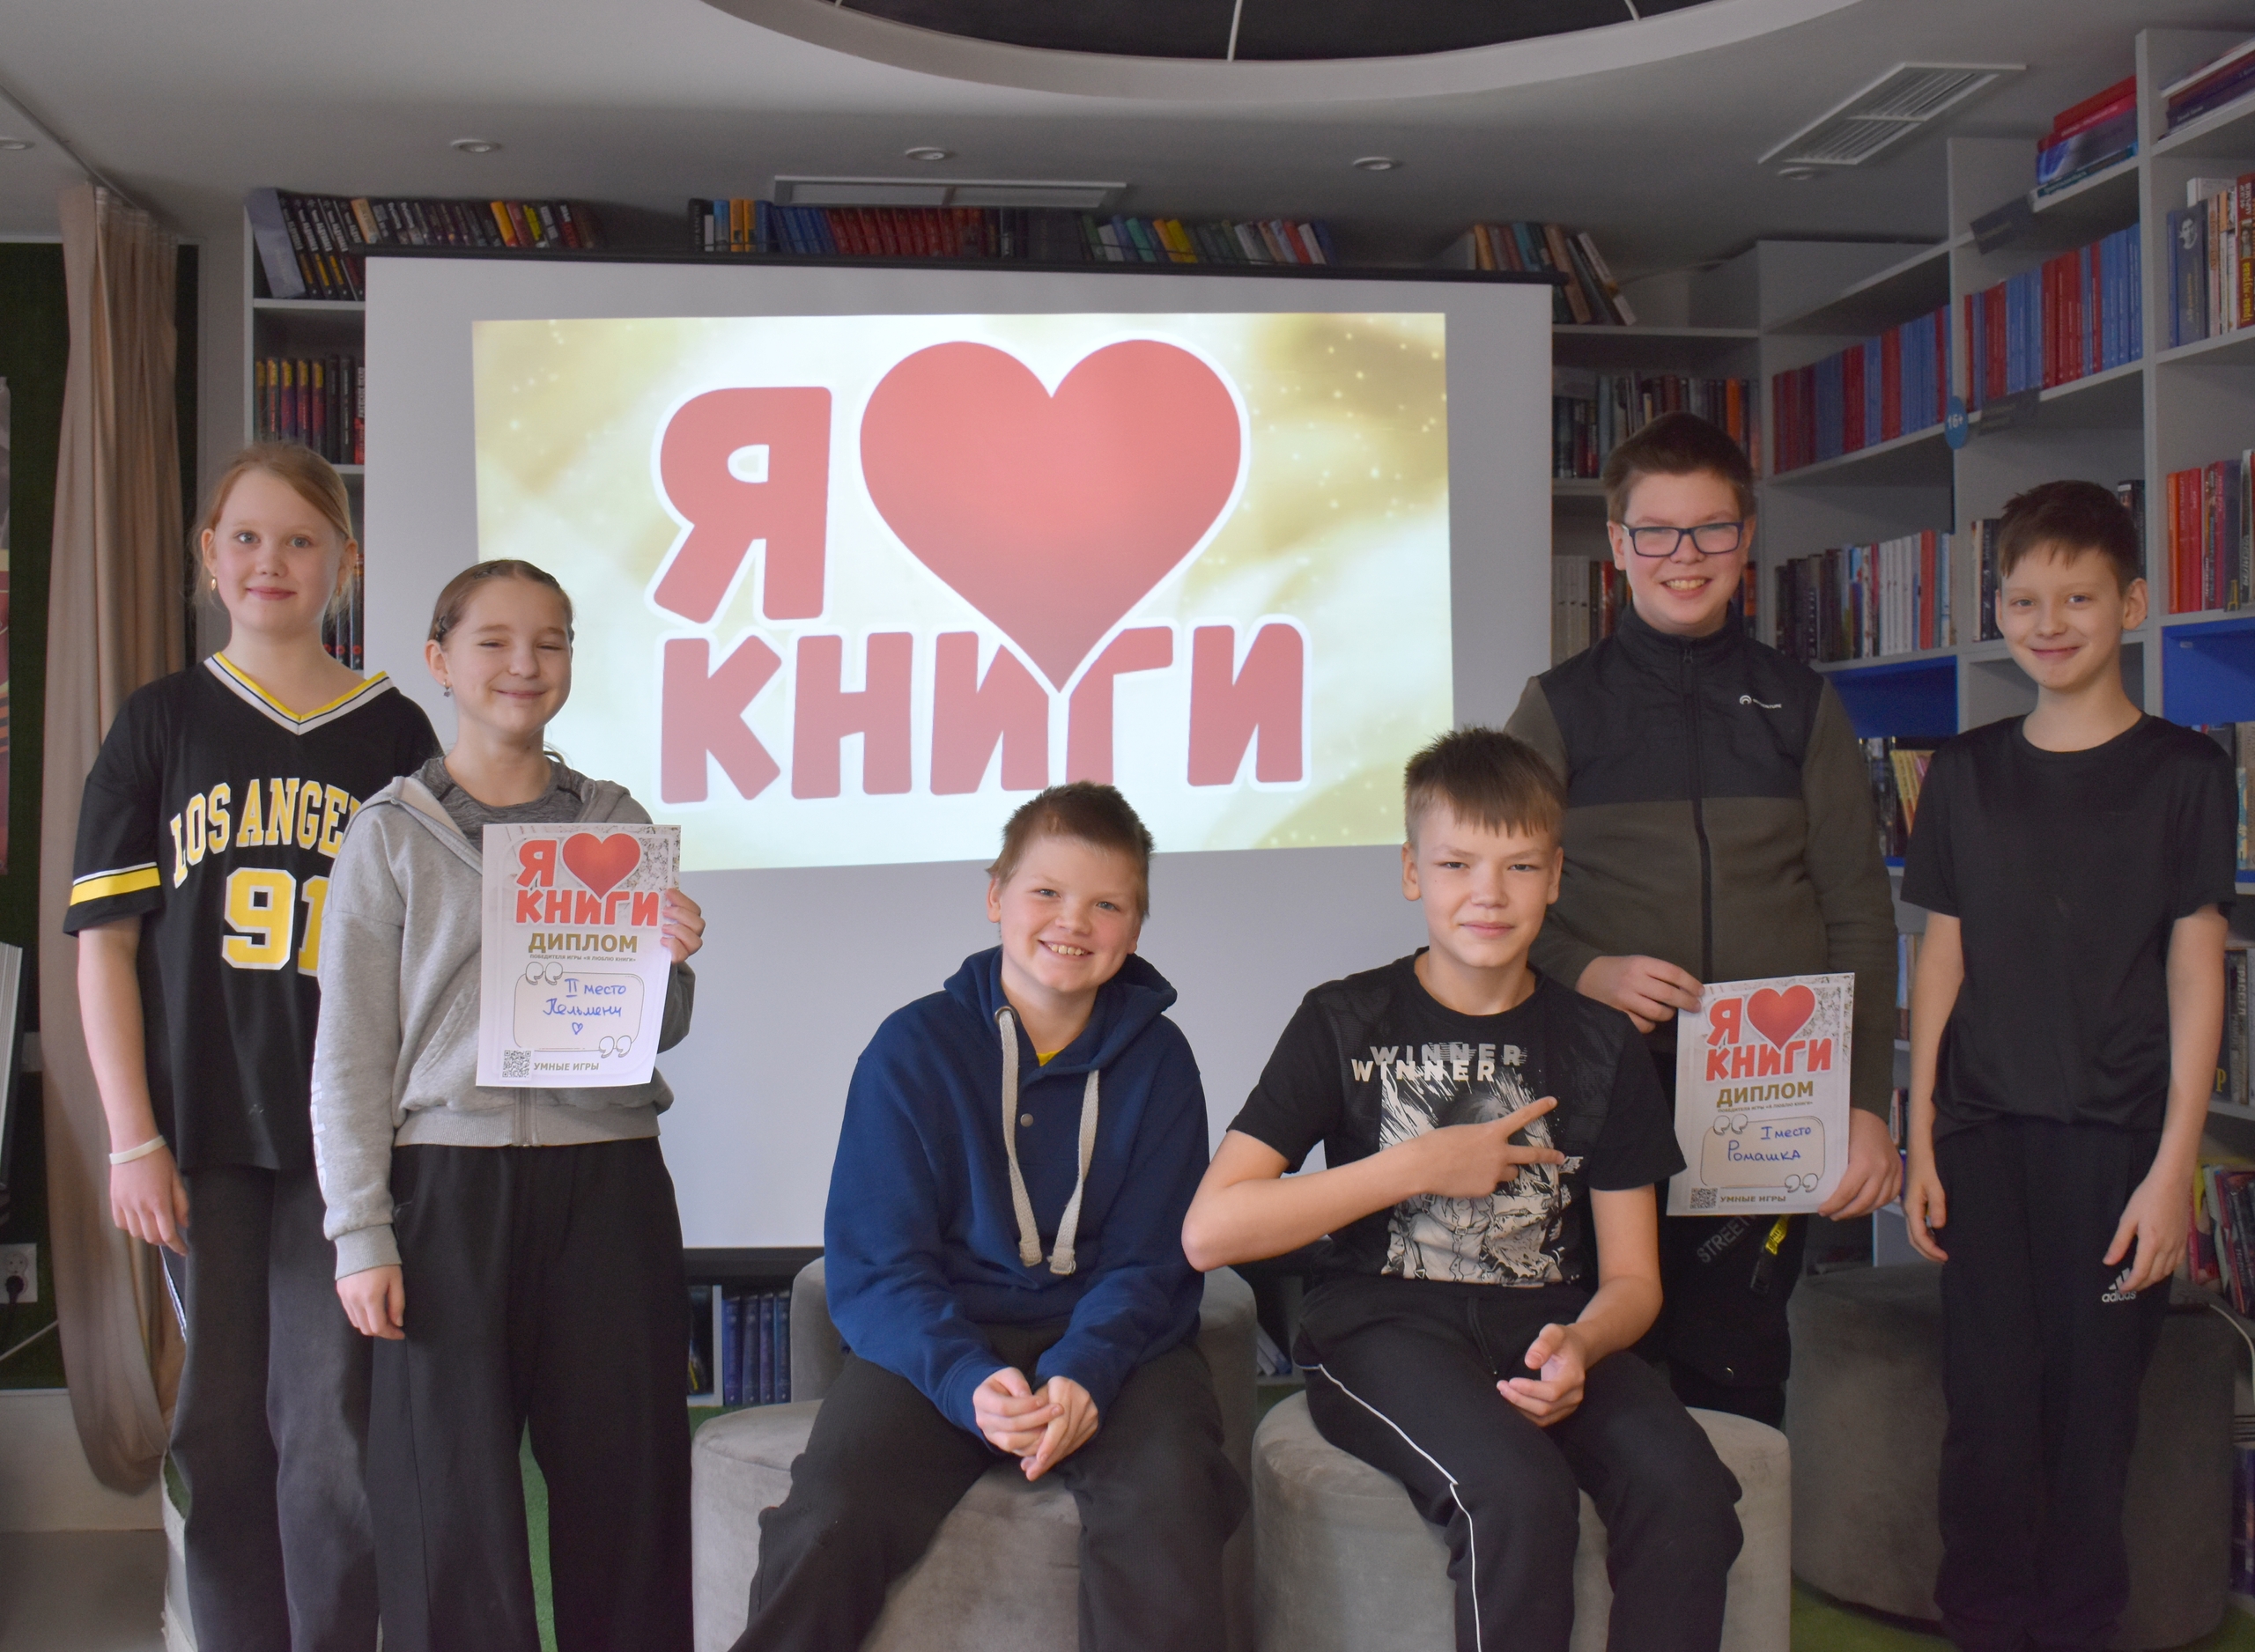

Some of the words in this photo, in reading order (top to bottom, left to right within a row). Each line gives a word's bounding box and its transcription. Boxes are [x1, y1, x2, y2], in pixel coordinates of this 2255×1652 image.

[653, 386, 832, 624] Я
[660, 623, 1304, 804] КНИГИ
[170, 783, 231, 889] LOS
[236, 777, 361, 859] ANGE
[516, 839, 558, 888] Я
[516, 889, 659, 926] КНИГИ
[222, 867, 329, 977] 91
[529, 933, 638, 953] ДИПЛОМ
[583, 985, 626, 995] место
[543, 998, 622, 1017] Пельмени
[1706, 998, 1742, 1046] Я
[534, 1062, 570, 1071] УМНЫЕ
[573, 1062, 599, 1071] ИГРЫ
[1370, 1043, 1527, 1066] WINNER
[1705, 1037, 1832, 1081] КНИГИ
[1351, 1058, 1495, 1082] WINNER
[1716, 1080, 1814, 1108] ДИПЛОМ
[1775, 1127, 1811, 1139] место
[1727, 1139, 1800, 1162] Ромашка
[1697, 1215, 1757, 1264] STREET
[2101, 1289, 2137, 1303] adidas
